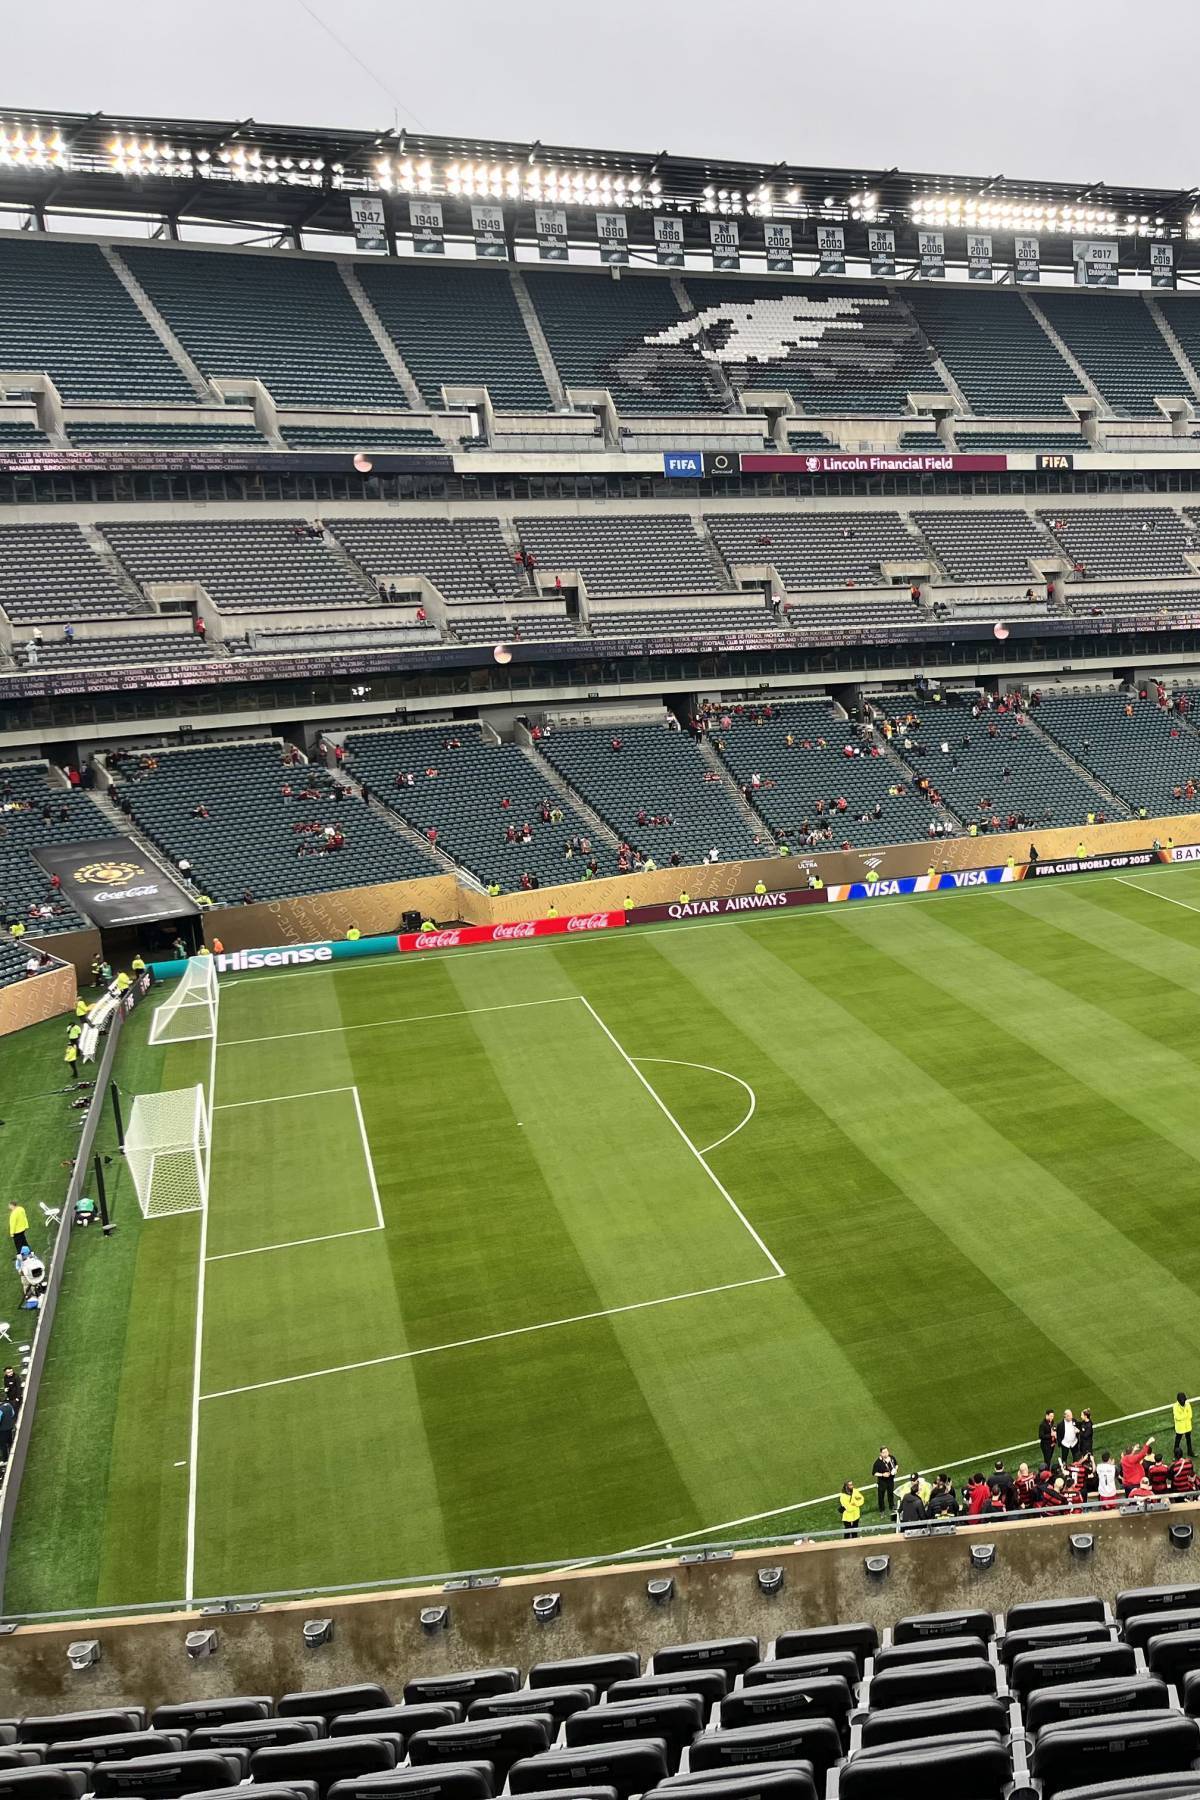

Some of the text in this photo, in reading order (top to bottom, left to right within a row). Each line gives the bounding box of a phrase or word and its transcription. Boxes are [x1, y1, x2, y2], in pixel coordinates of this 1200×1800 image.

[356, 211, 380, 222] 1947
[414, 215, 439, 226] 1948
[477, 218, 500, 230] 1949
[540, 222, 563, 234] 1960
[600, 227, 624, 238] 1980
[658, 229, 680, 240] 1988
[714, 234, 735, 244] 2001
[768, 237, 790, 247] 2002
[820, 239, 842, 249] 2003
[871, 241, 892, 252] 2004
[921, 244, 942, 253] 2006
[971, 247, 989, 256] 2010
[1018, 249, 1036, 258] 2013
[1093, 250, 1111, 259] 2017
[1153, 255, 1170, 264] 2019
[669, 460, 696, 470] FIFA
[824, 458, 953, 470] Lincoln Financial Field
[1042, 457, 1068, 468] FIFA
[1036, 864, 1055, 876] FIFA
[1056, 862, 1078, 874] CLUB
[1079, 859, 1108, 872] WORLD
[1110, 857, 1128, 867] CUP
[952, 871, 988, 887] VISA
[94, 884, 159, 902] Coca-Cola
[862, 880, 900, 897] VISA
[668, 893, 787, 919] QATAR AIRWAYS
[567, 913, 609, 931] Coca-Cola
[492, 922, 536, 940] Coca-Cola
[415, 929, 460, 949] Coca-Cola
[216, 946, 332, 973] Hisense
[1025, 1479, 1035, 1491] 10
